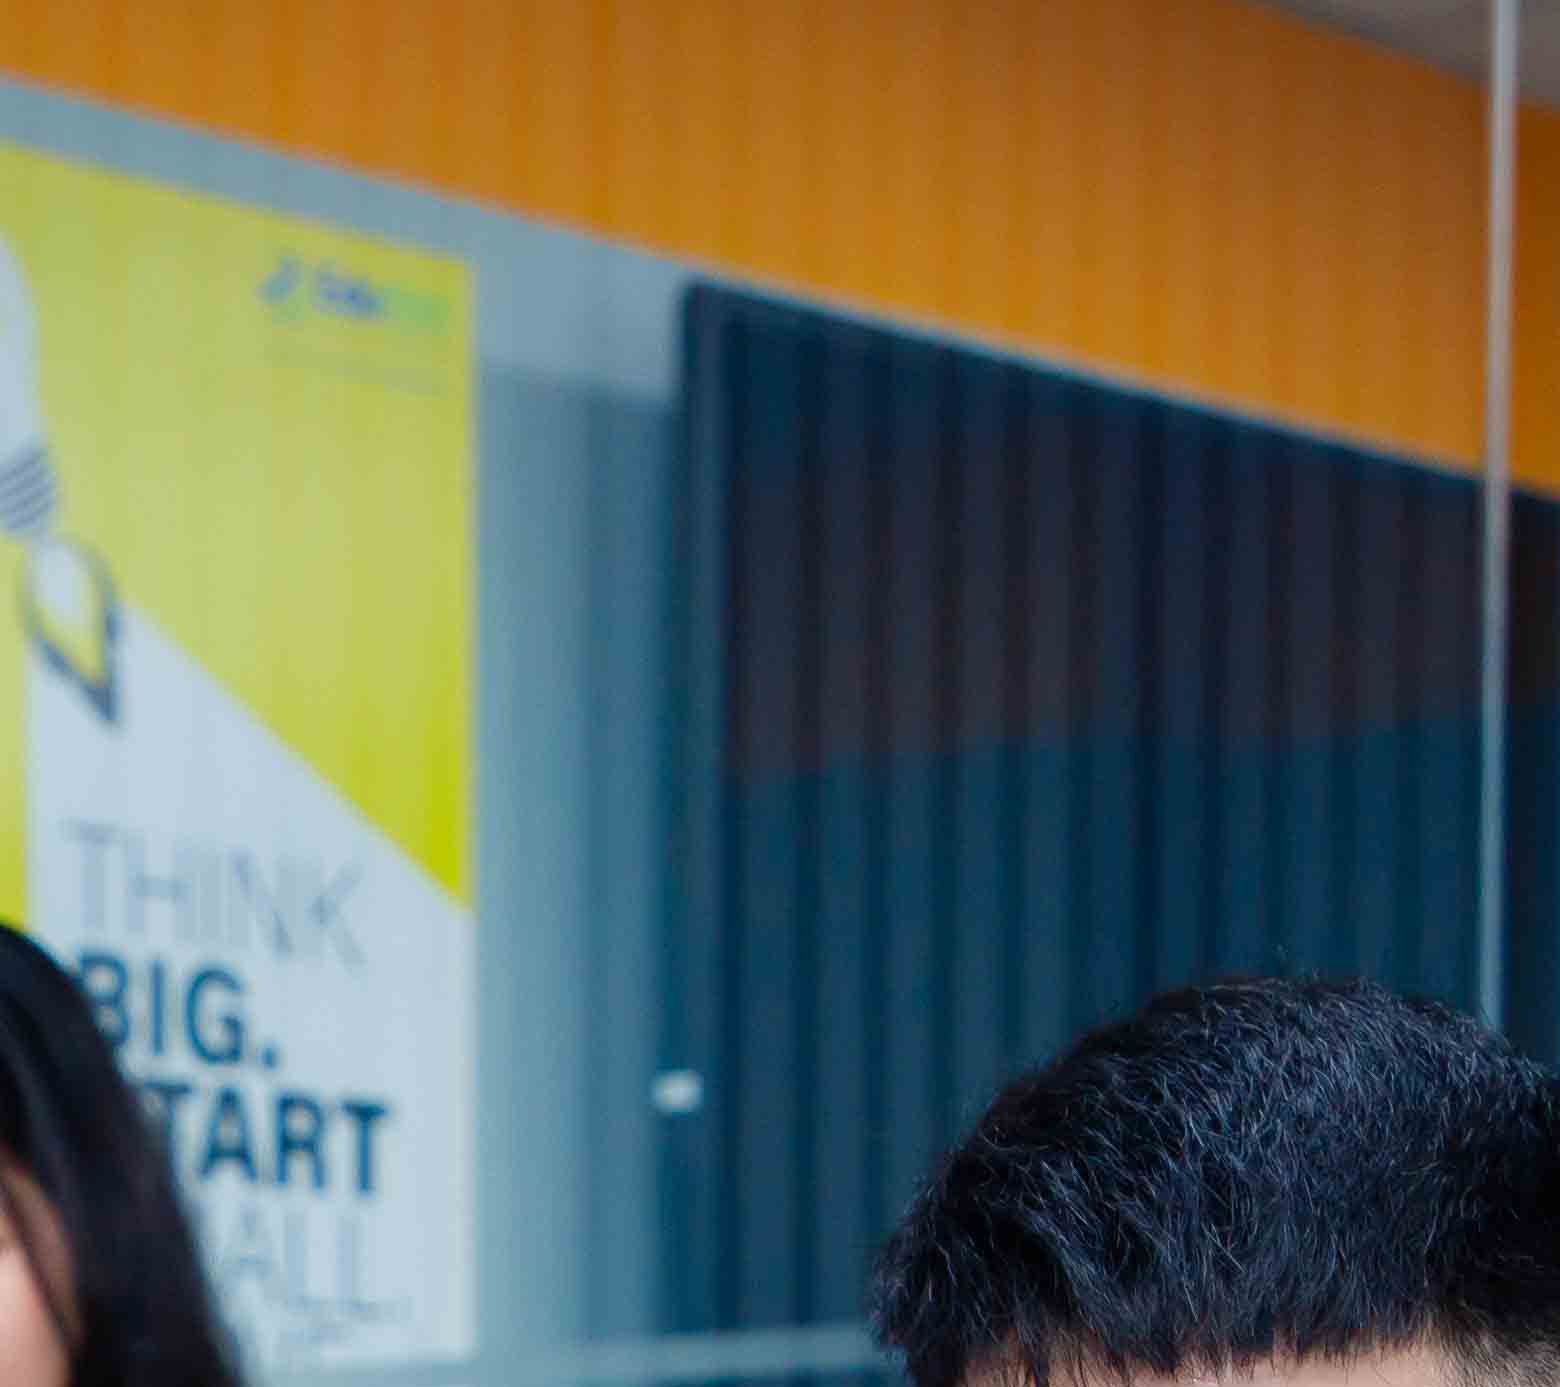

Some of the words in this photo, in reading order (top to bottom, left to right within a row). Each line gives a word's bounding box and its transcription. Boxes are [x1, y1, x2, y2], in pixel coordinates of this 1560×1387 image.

[60, 816, 367, 976] THINK
[77, 949, 281, 1071] BIG.
[142, 1080, 391, 1196] TART
[215, 1198, 412, 1326] ALL
